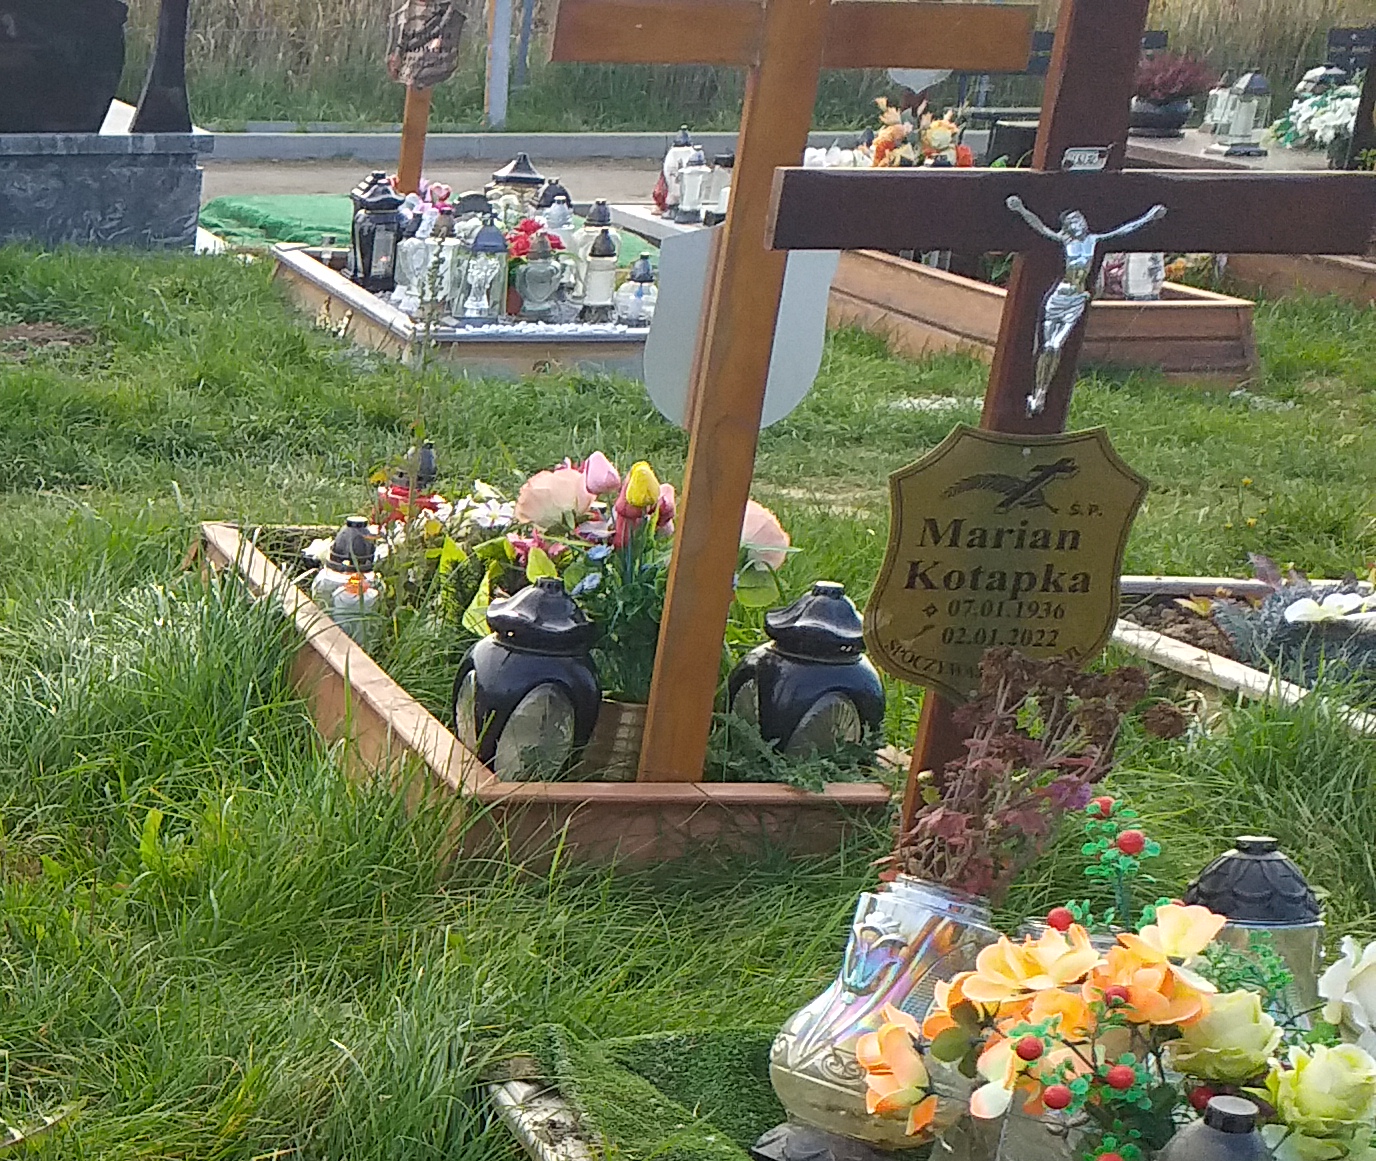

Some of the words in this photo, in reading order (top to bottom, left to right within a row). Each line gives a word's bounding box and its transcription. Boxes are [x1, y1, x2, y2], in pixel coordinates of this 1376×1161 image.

[916, 517, 1082, 551] Marian
[904, 559, 1092, 601] Kotapka
[947, 600, 1066, 620] 07.01.1936
[941, 626, 1060, 648] 02.01.2022
